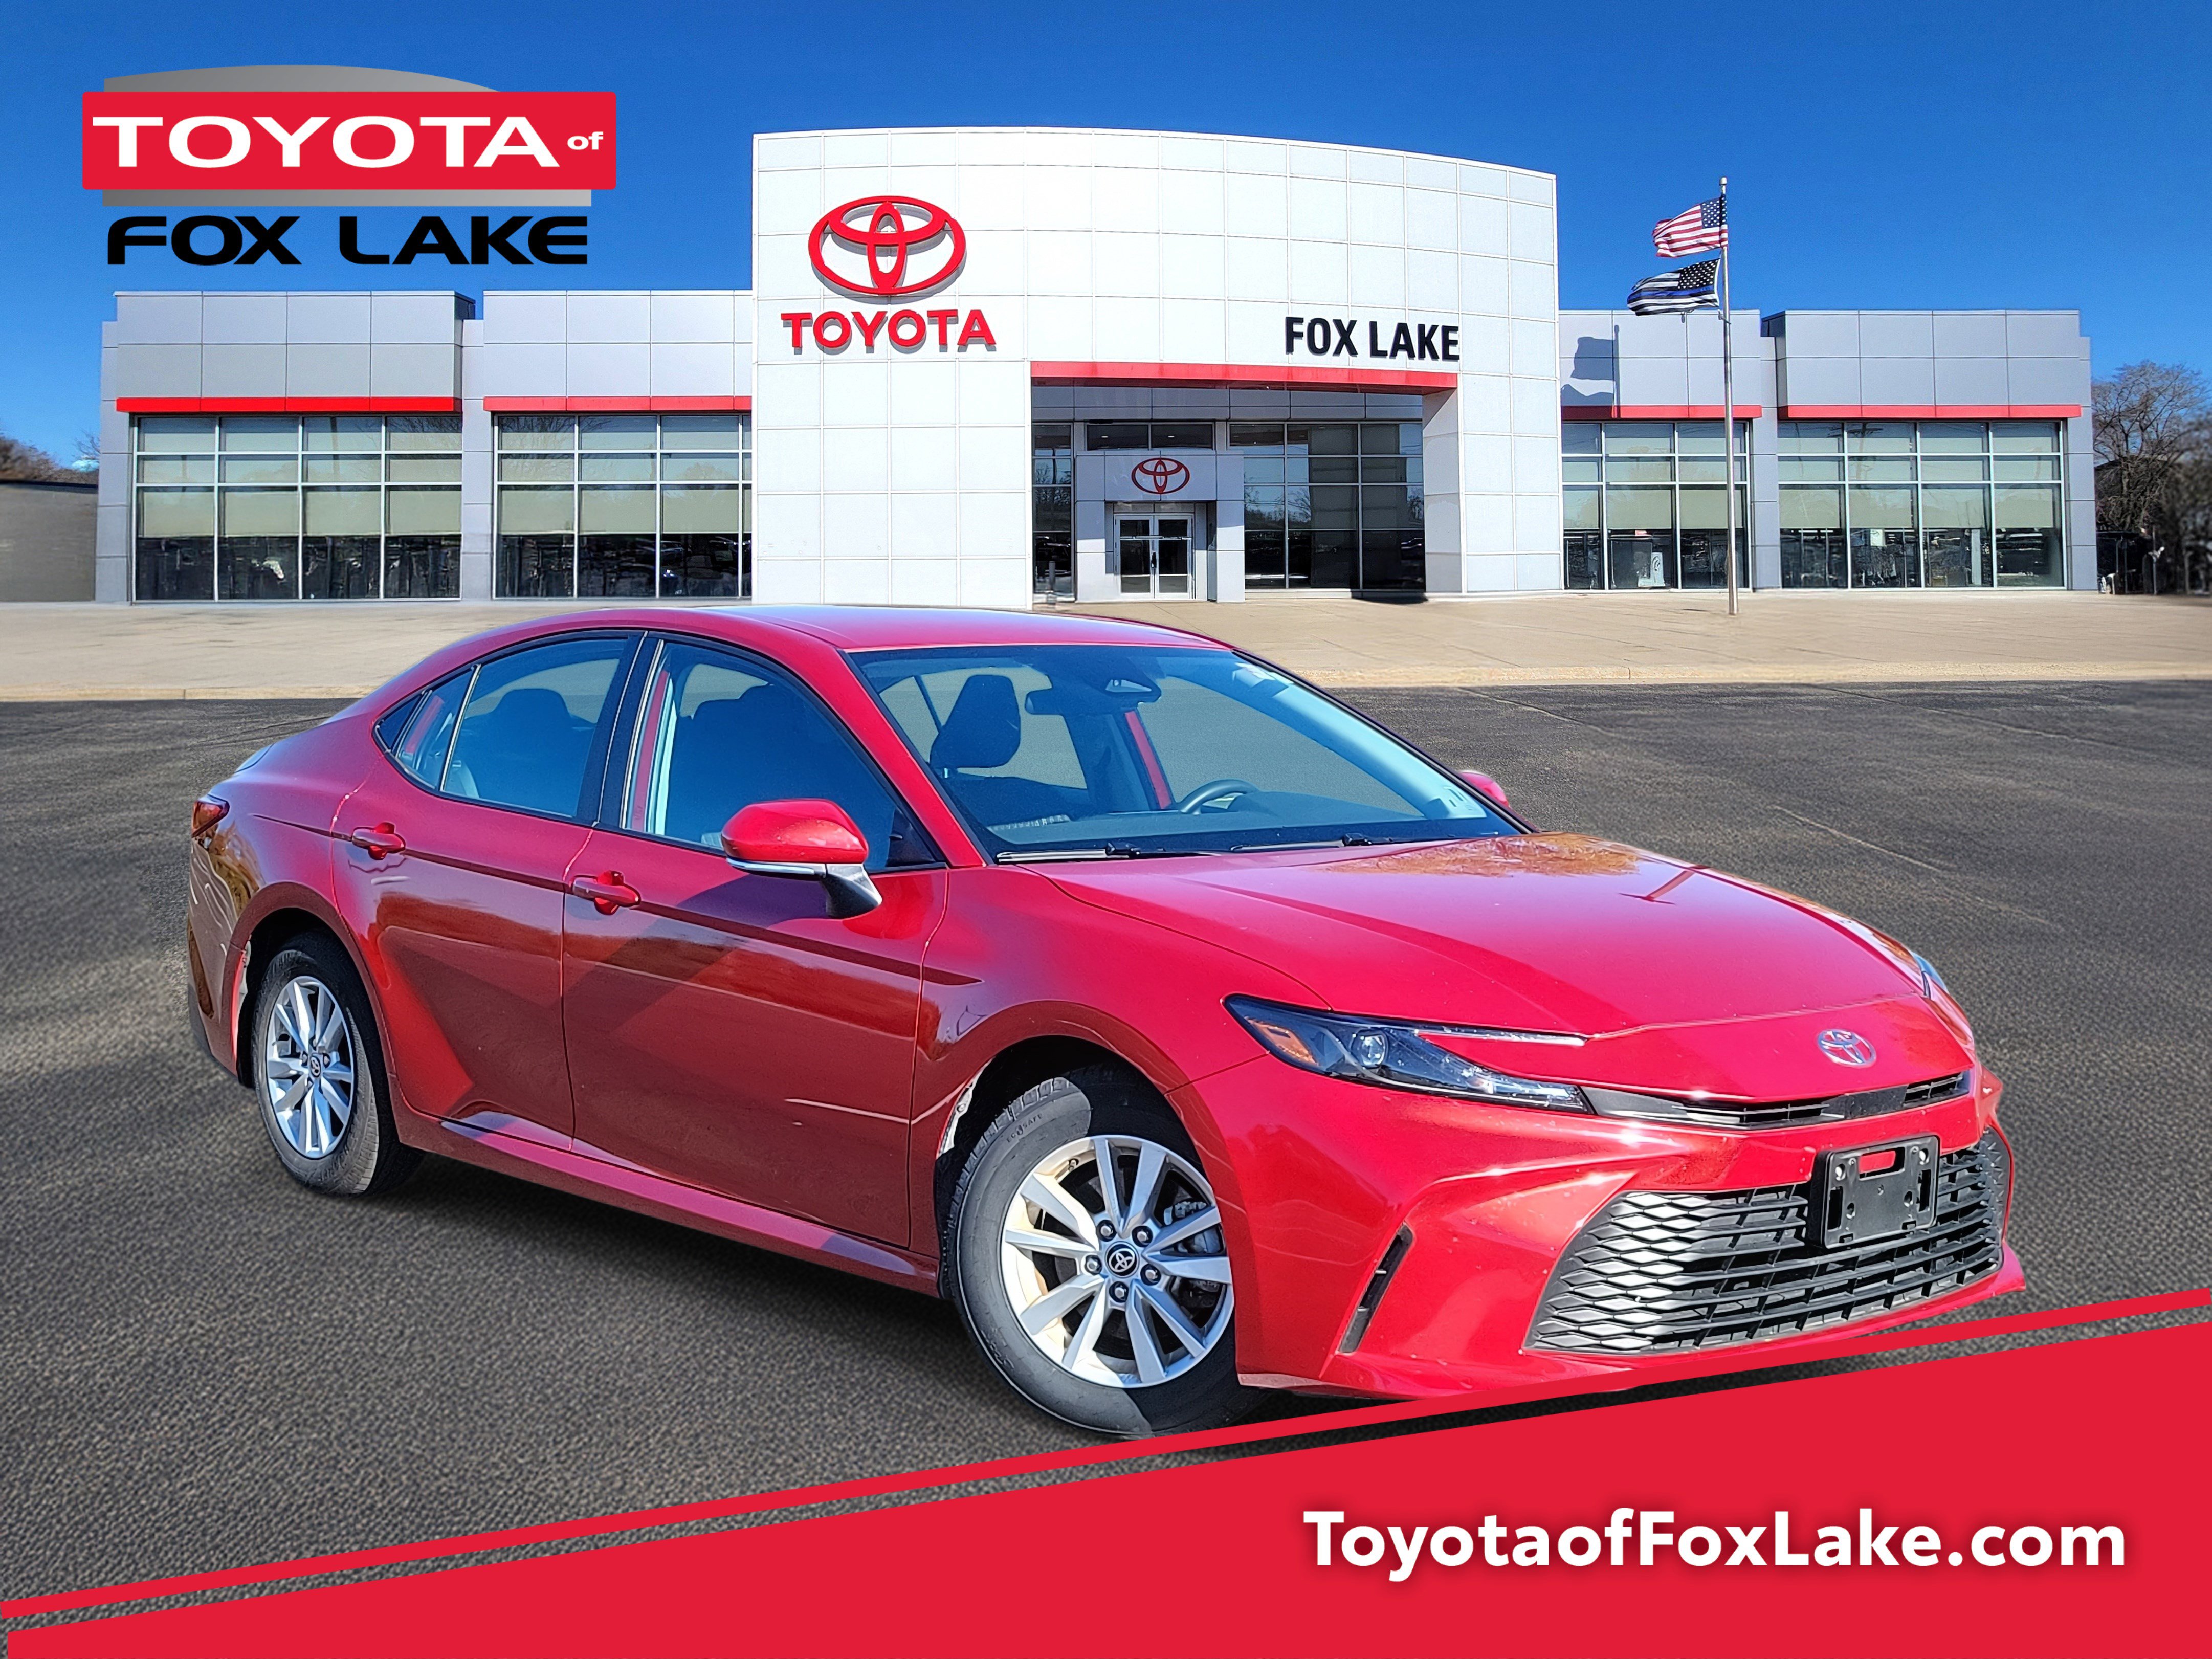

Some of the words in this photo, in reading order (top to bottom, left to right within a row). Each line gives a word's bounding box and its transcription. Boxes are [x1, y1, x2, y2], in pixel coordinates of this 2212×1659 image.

[781, 309, 997, 349] TOYOTA
[1286, 317, 1358, 357] FOX
[1369, 321, 1460, 360] LAKE
